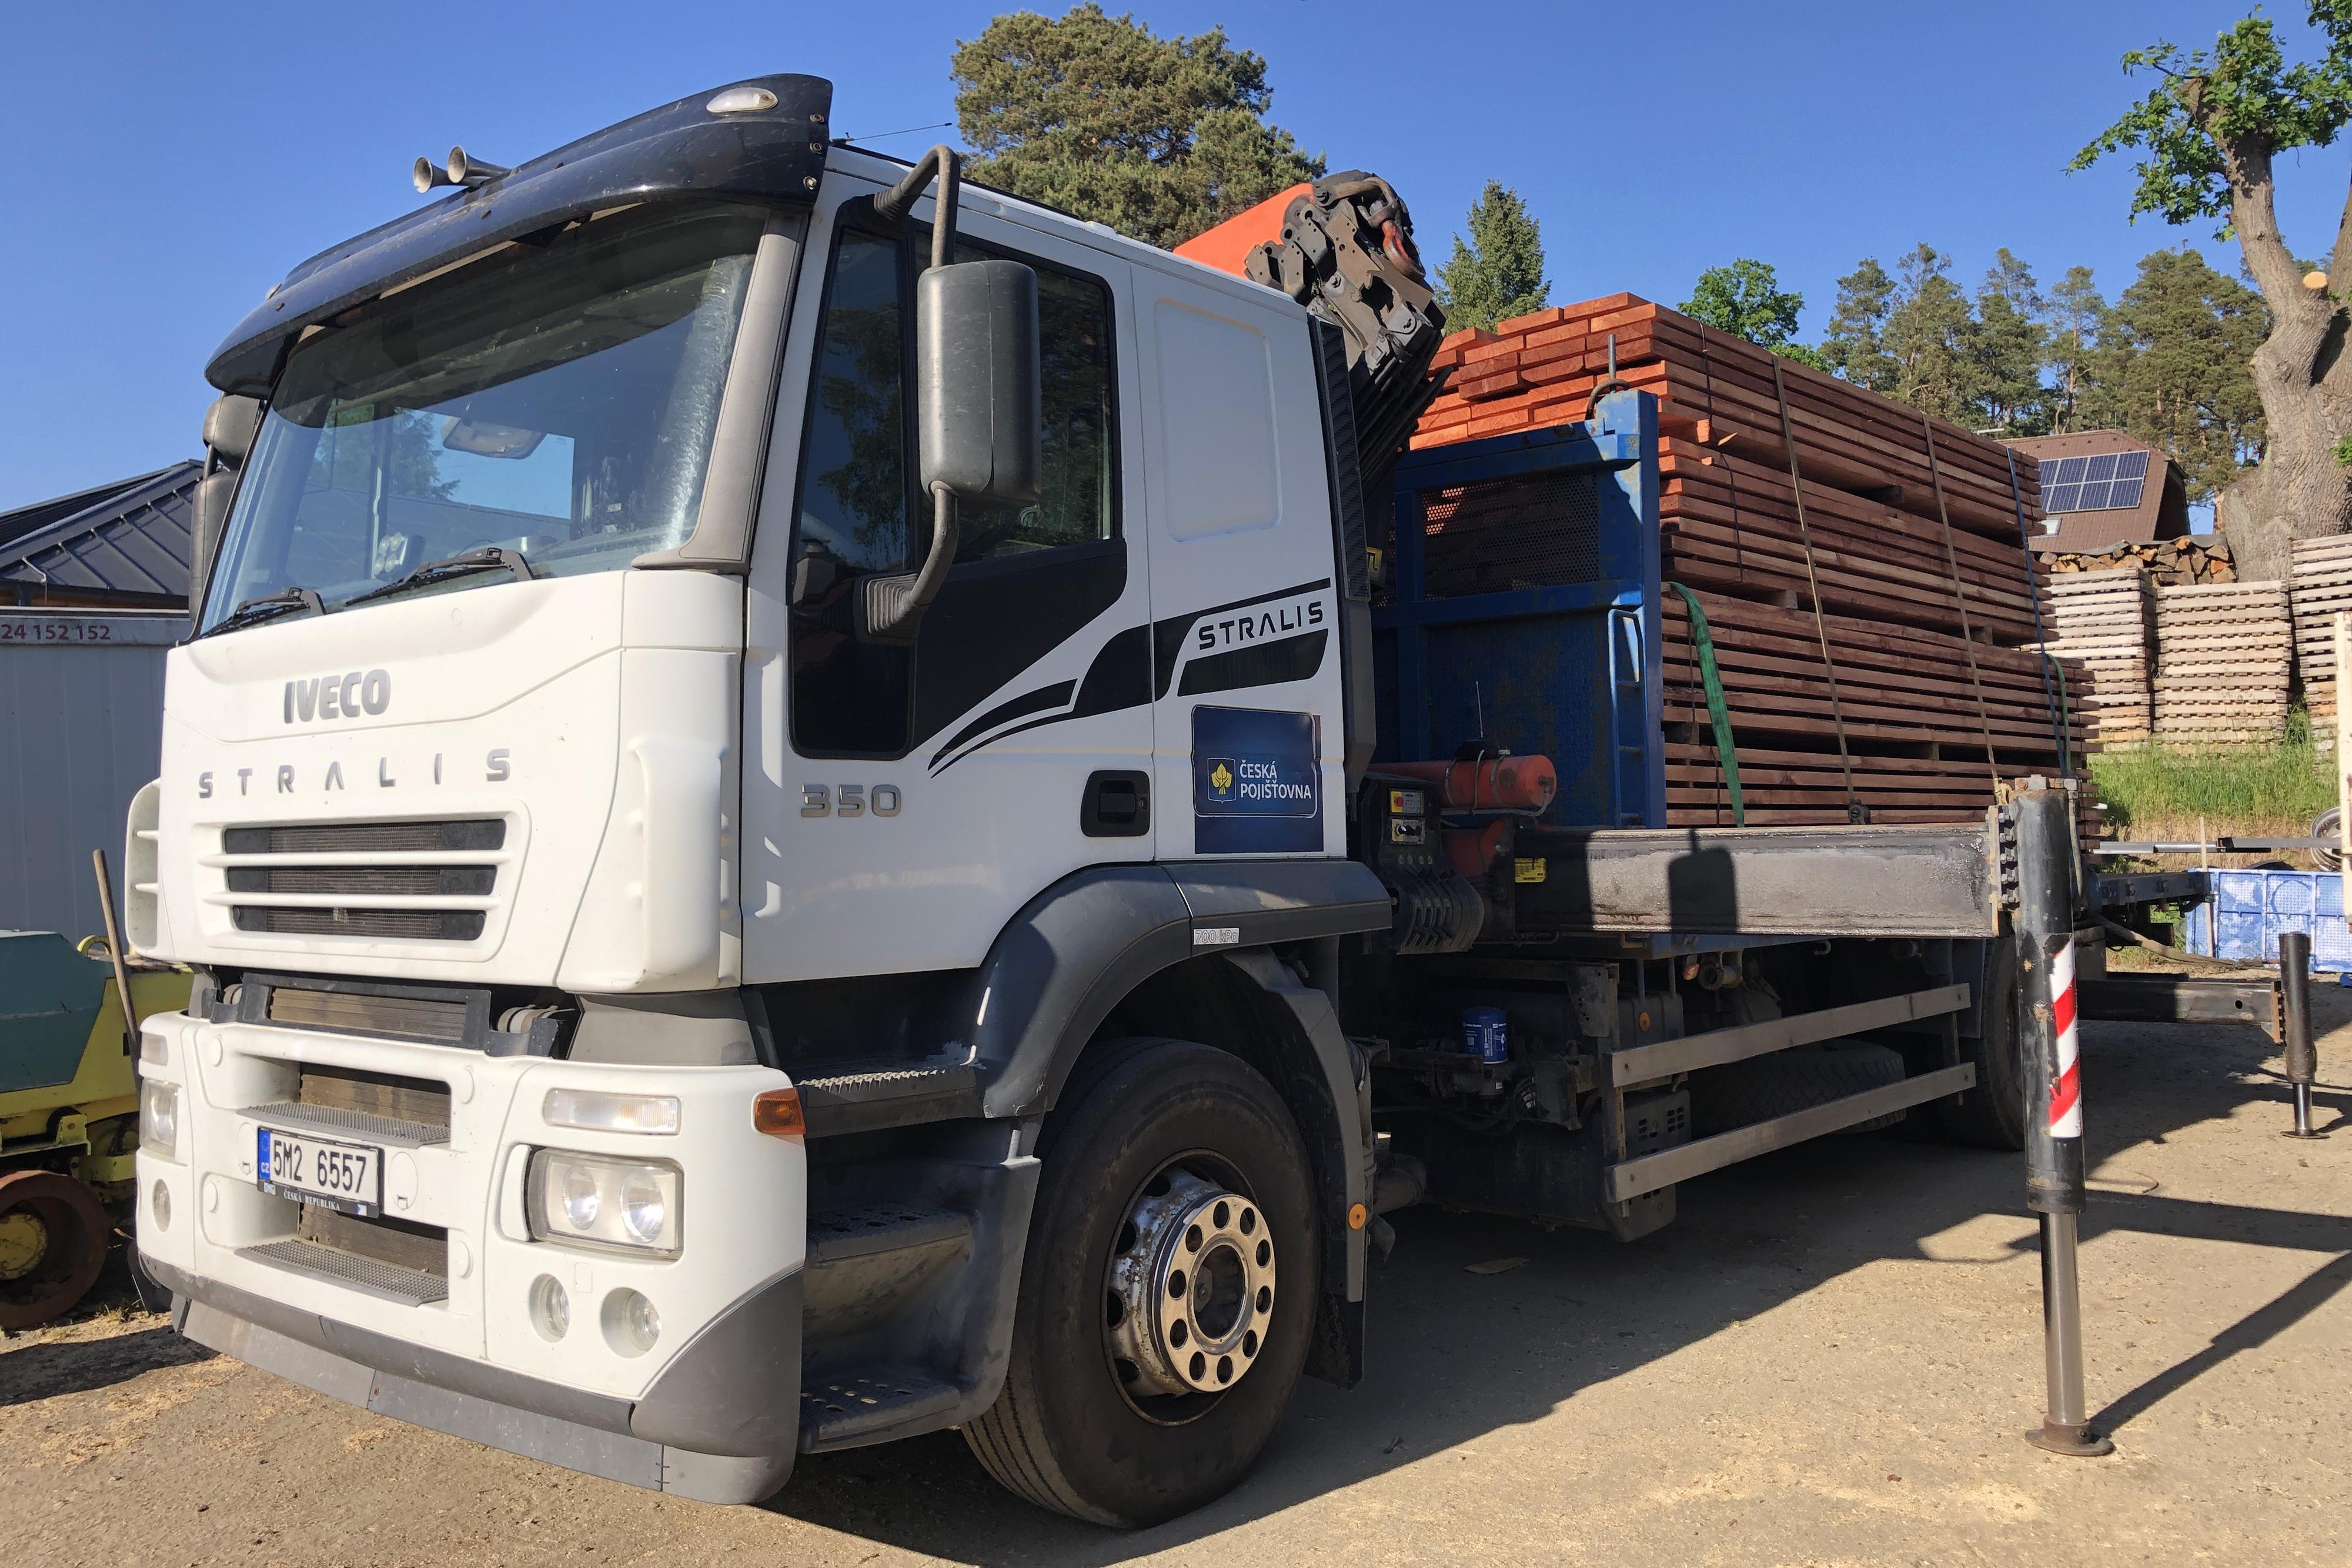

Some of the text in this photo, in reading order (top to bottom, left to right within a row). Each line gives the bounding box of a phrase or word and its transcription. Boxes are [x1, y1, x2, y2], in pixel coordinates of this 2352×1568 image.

[1, 624, 111, 640] 24 152 152
[1198, 600, 1323, 650] STRALIS
[283, 668, 391, 724] IVECO
[198, 748, 510, 798] STRALIS
[1240, 759, 1278, 779] ČESKÁ
[801, 783, 902, 818] 350
[1240, 780, 1312, 800] POJIŠŤOVNA
[1195, 929, 1238, 944] 700 kPa
[260, 1162, 270, 1174] CZ
[273, 1139, 366, 1193] 5M2 6557
[283, 1188, 340, 1211] ČESKÁ REPUBLIKA
